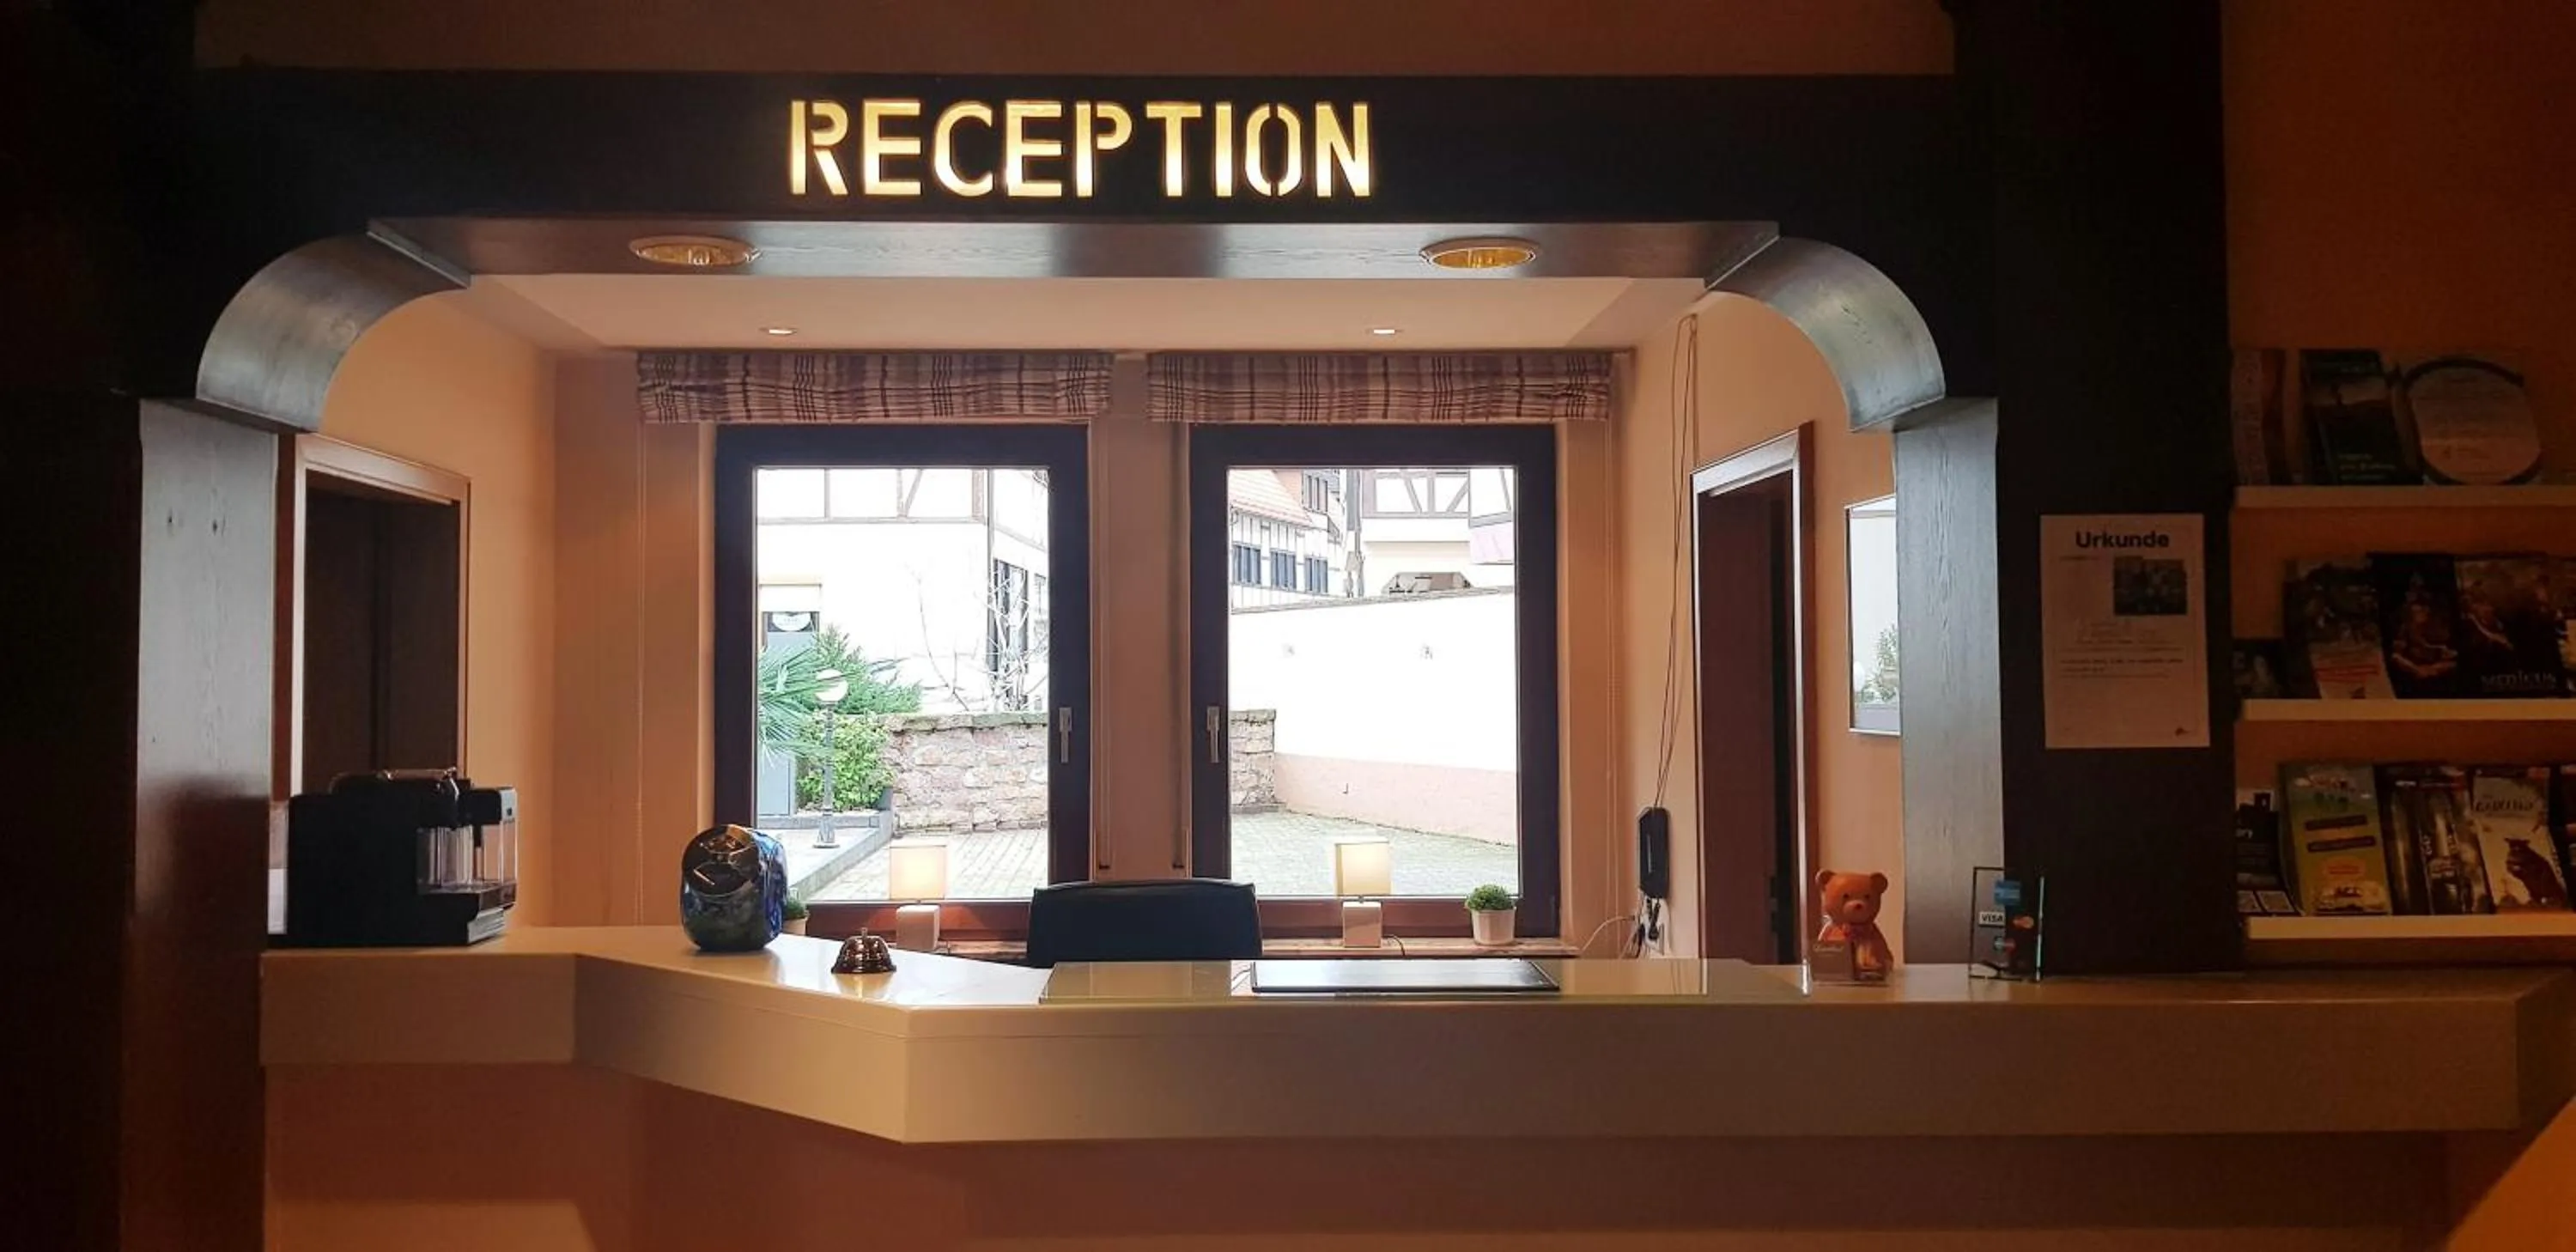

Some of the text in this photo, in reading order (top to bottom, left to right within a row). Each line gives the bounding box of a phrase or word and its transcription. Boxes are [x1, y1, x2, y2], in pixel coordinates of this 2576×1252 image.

[789, 99, 1372, 198] RECEPTION
[2075, 530, 2171, 549] Urkunde
[1981, 914, 2003, 922] VISA
